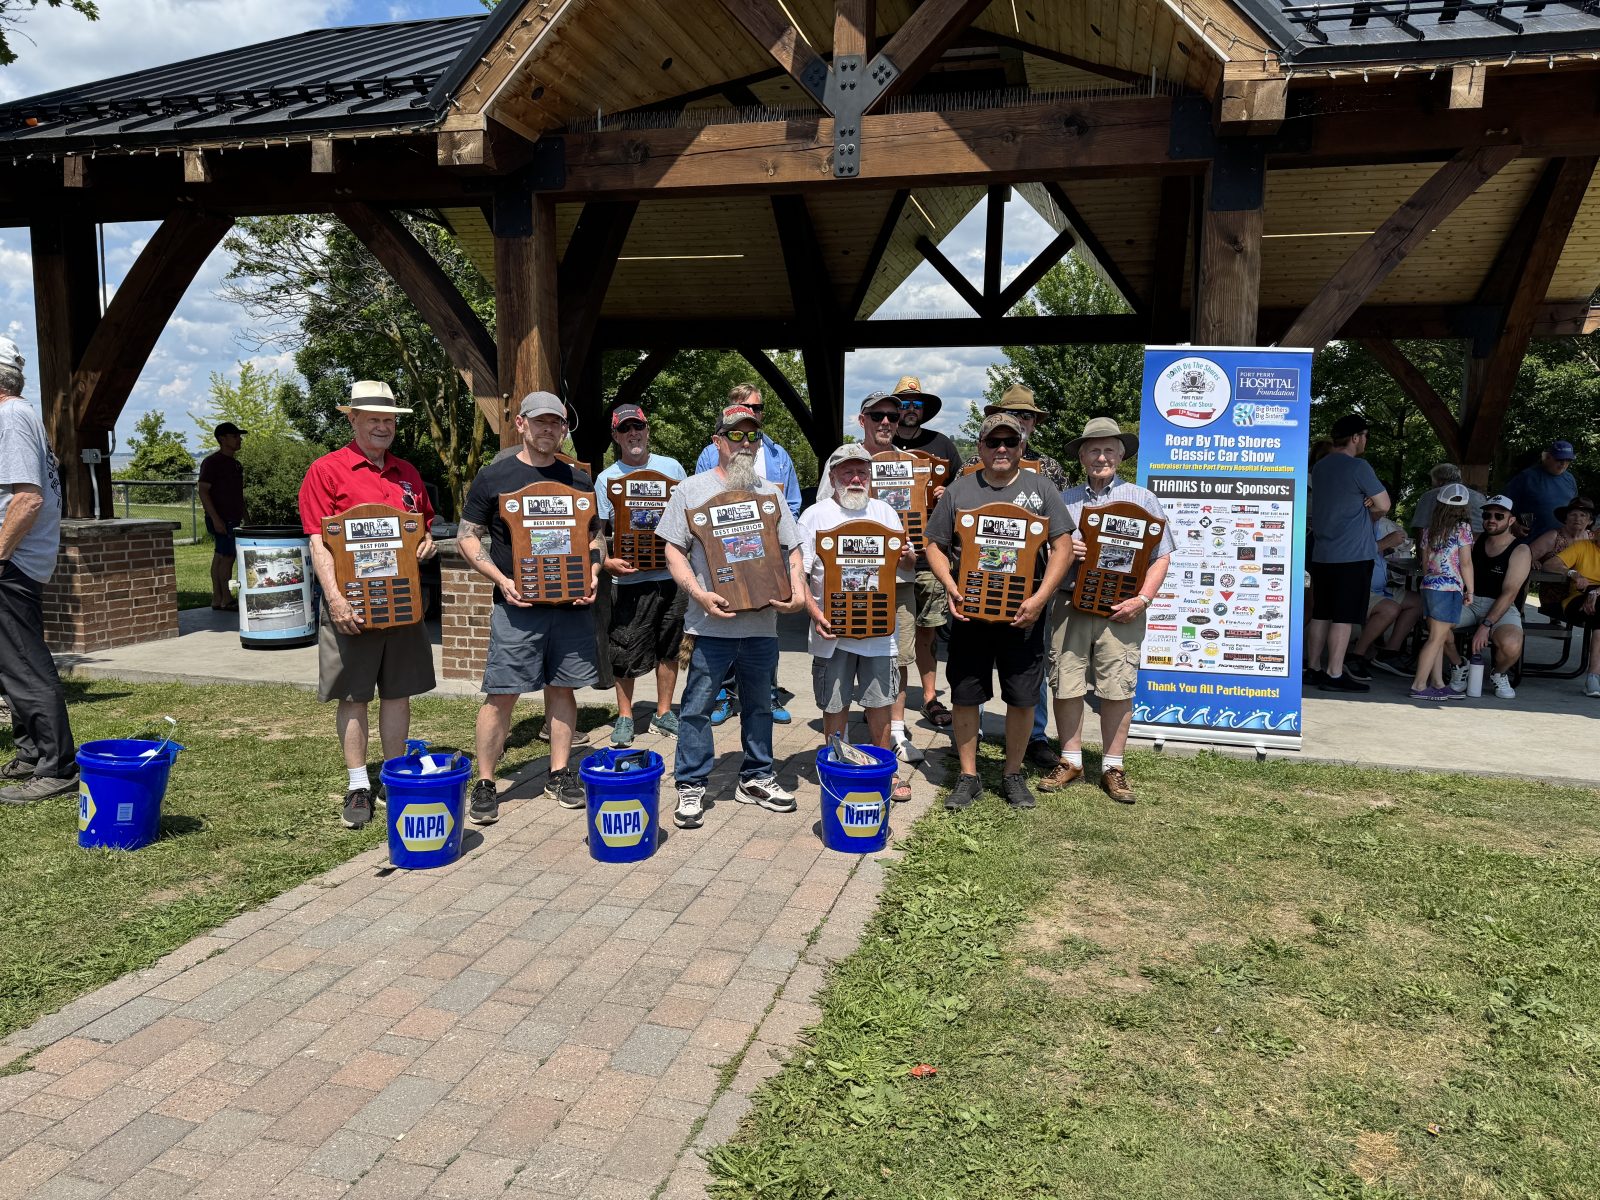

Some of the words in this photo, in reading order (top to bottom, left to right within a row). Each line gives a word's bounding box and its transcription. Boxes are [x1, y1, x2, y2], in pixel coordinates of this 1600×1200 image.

[1240, 378, 1295, 388] HOSPITAL
[1256, 388, 1294, 396] Foundation
[1165, 434, 1194, 446] Roar
[1196, 435, 1211, 448] By
[1213, 435, 1235, 447] The
[1238, 435, 1281, 449] Shores
[1170, 448, 1215, 461] Classic
[1218, 449, 1239, 462] Car
[1241, 450, 1275, 463] Show
[1153, 479, 1197, 493] THANKS
[1200, 481, 1211, 493] to
[1214, 483, 1233, 494] our
[1236, 482, 1290, 496] Sponsors:
[528, 499, 550, 508] ROAR
[717, 507, 737, 517] ROAR
[351, 521, 375, 532] ROAR
[731, 523, 762, 533] INTERIOR
[983, 518, 1004, 530] ROAR
[1107, 517, 1126, 528] ROAR
[843, 539, 863, 548] ROAR
[1147, 681, 1176, 692] Thank
[1179, 682, 1197, 693] You
[1200, 684, 1214, 694] All
[1216, 685, 1280, 698] Participants!
[845, 804, 880, 825] NAPA
[404, 815, 445, 839] NAPA
[602, 811, 641, 834] NAPA
